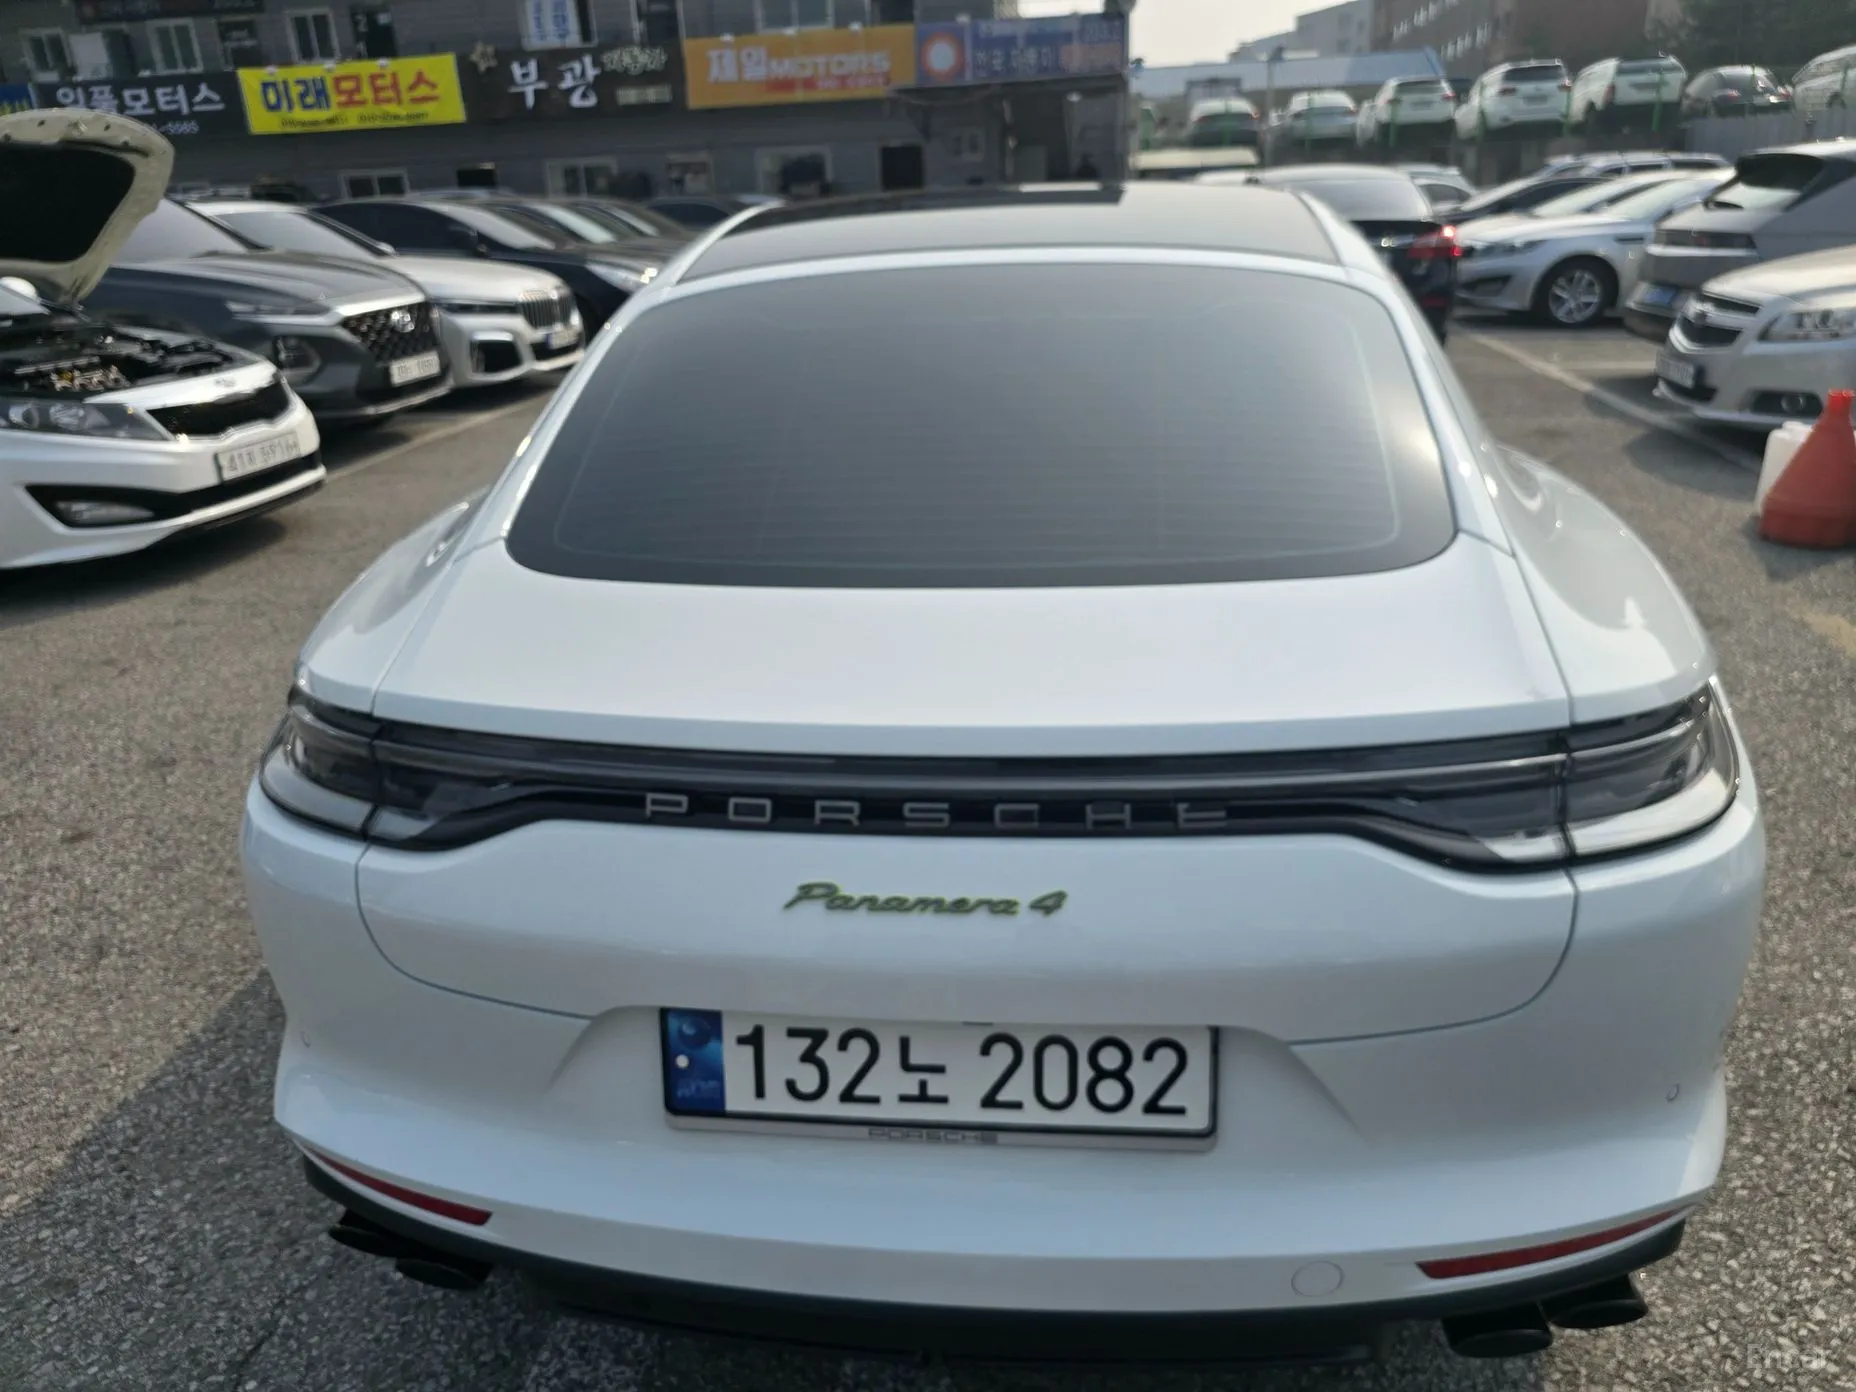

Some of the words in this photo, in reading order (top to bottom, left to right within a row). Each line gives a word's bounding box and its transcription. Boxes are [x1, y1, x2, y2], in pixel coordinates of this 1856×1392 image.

[260, 68, 440, 113] 미래모터스
[645, 792, 1228, 831] PORSCHE
[782, 881, 1021, 916] Panamera
[1028, 888, 1069, 917] 4
[735, 1024, 949, 1105] 132노
[979, 1032, 1189, 1116] 2082
[867, 1127, 999, 1145] PORSCHE
